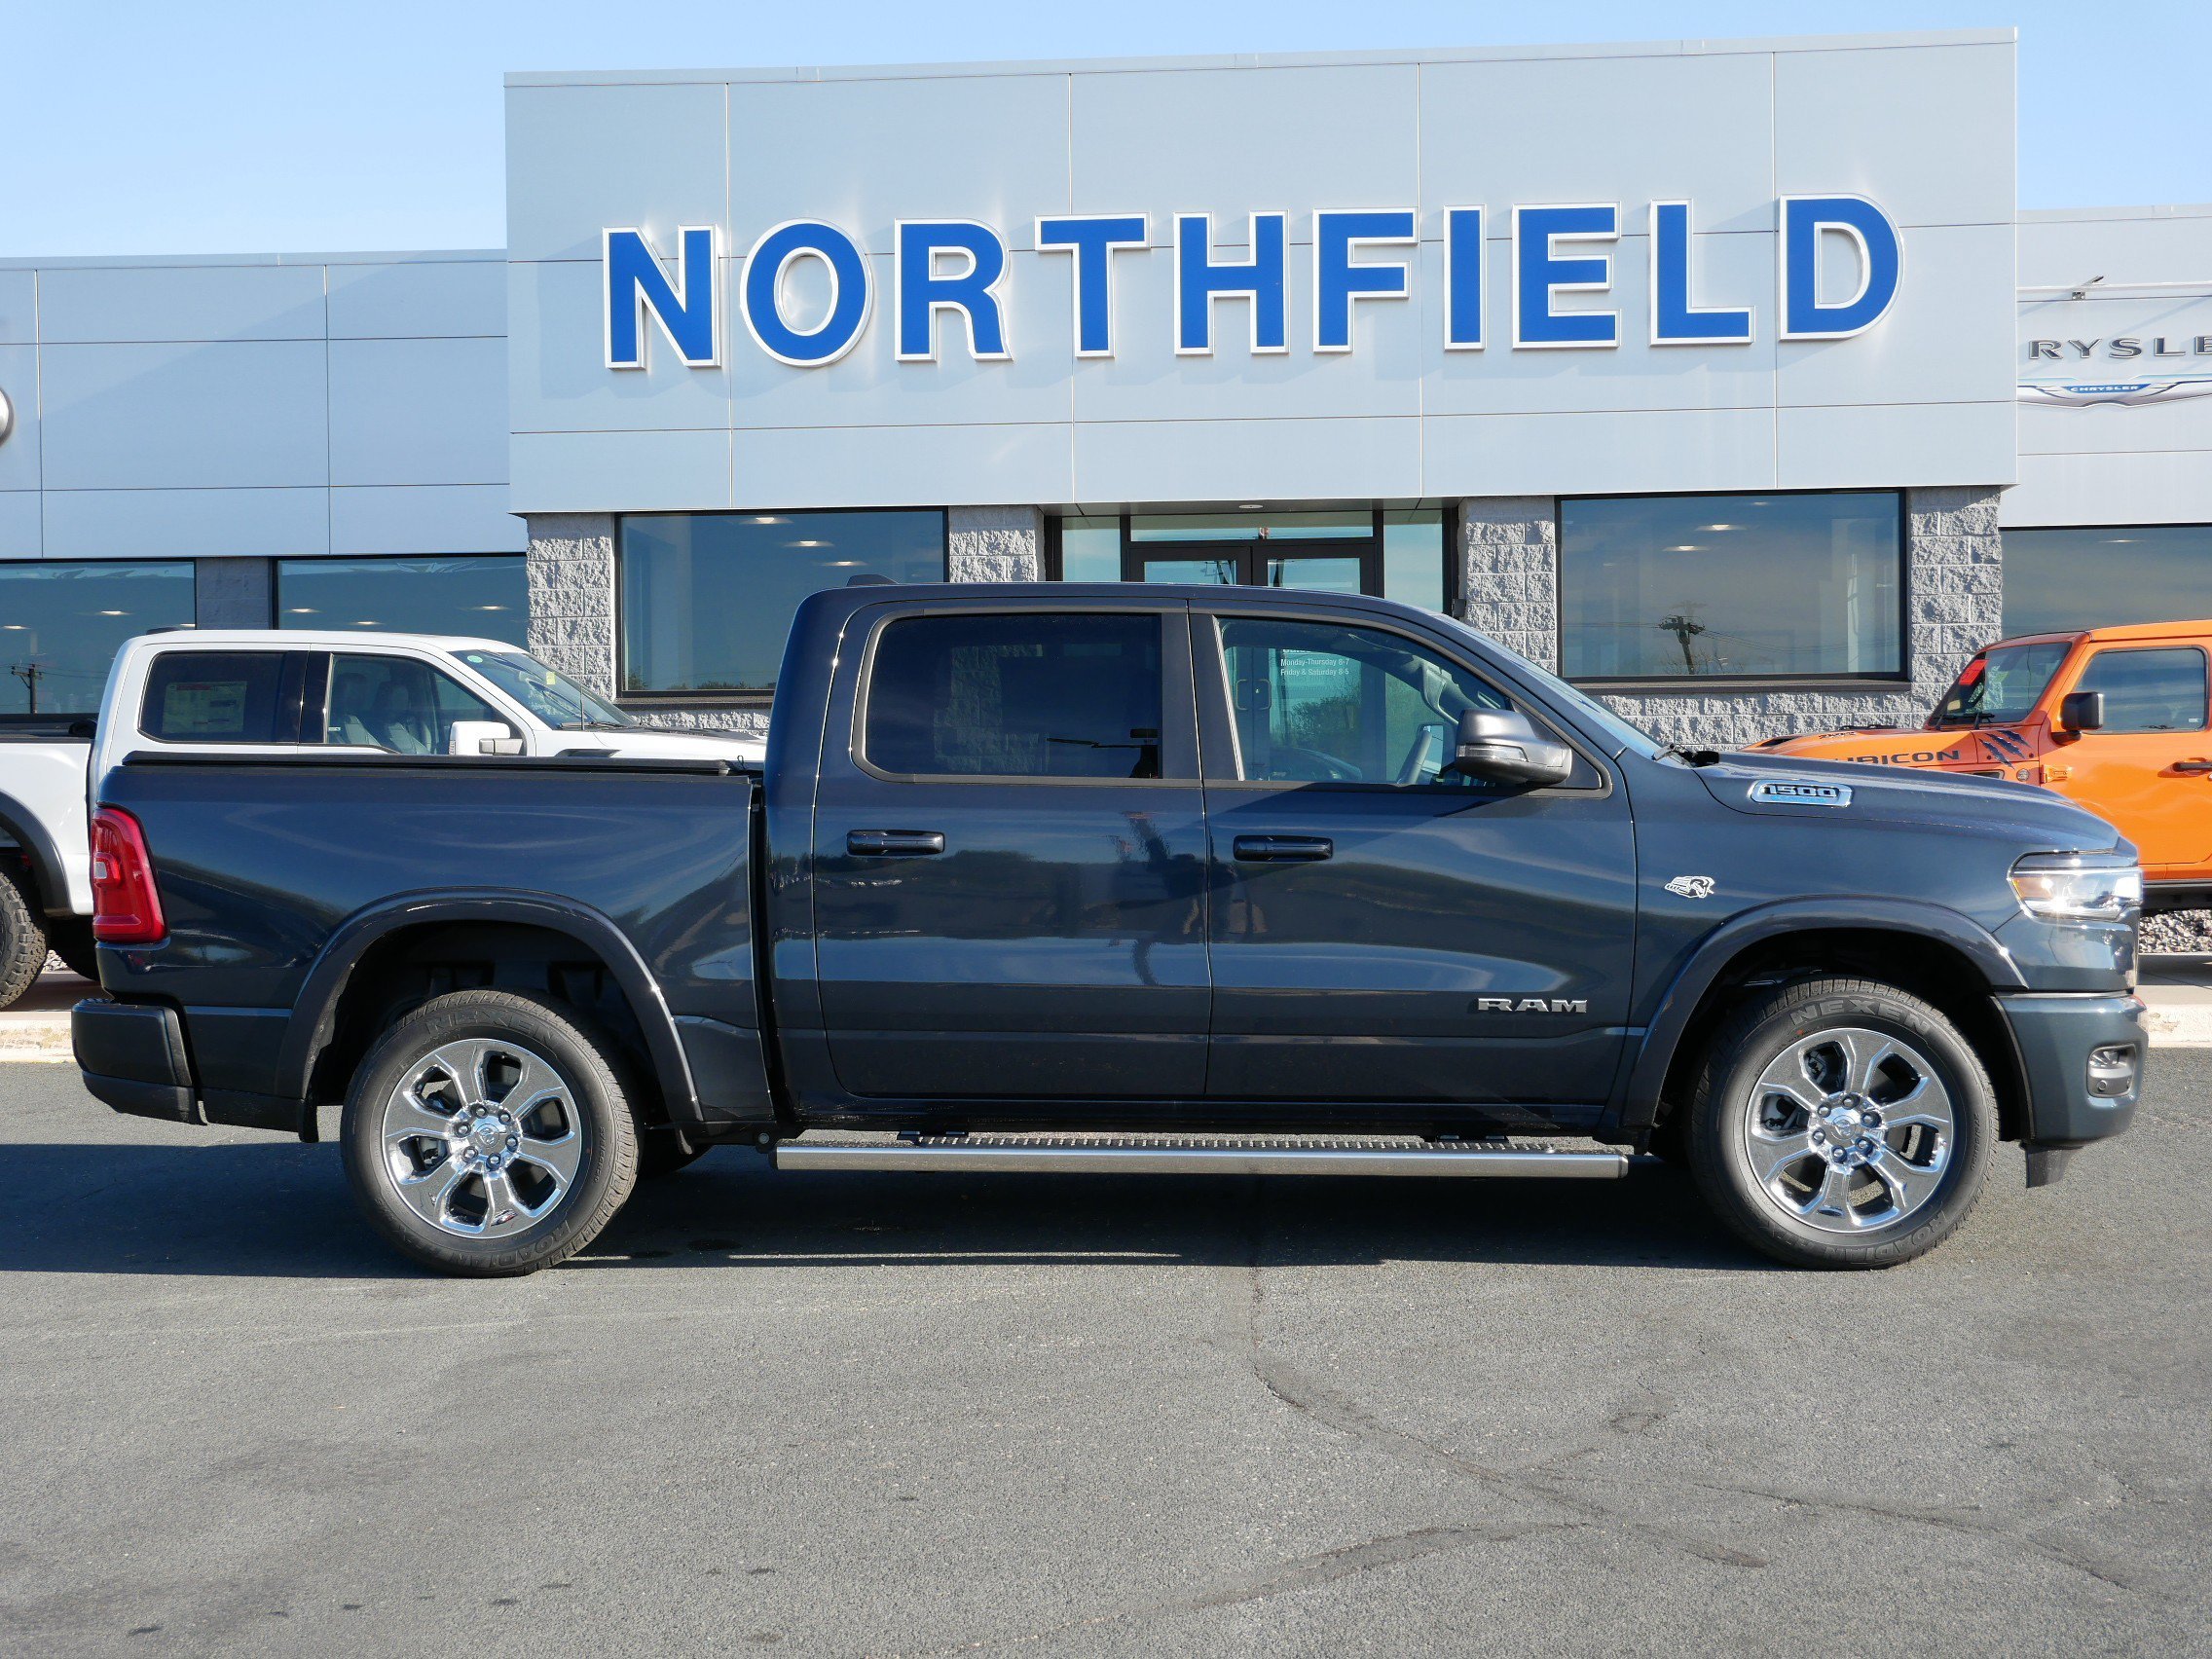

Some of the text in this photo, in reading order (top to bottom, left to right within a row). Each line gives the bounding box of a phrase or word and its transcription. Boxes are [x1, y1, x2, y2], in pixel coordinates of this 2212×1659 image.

[603, 193, 1903, 369] NORTHFIELD
[1835, 750, 1960, 764] BICON
[1765, 784, 1839, 797] 1500
[1477, 997, 1588, 1014] RAM
[1790, 999, 1932, 1034] NEXEN
[424, 1011, 556, 1043] NEXEN
